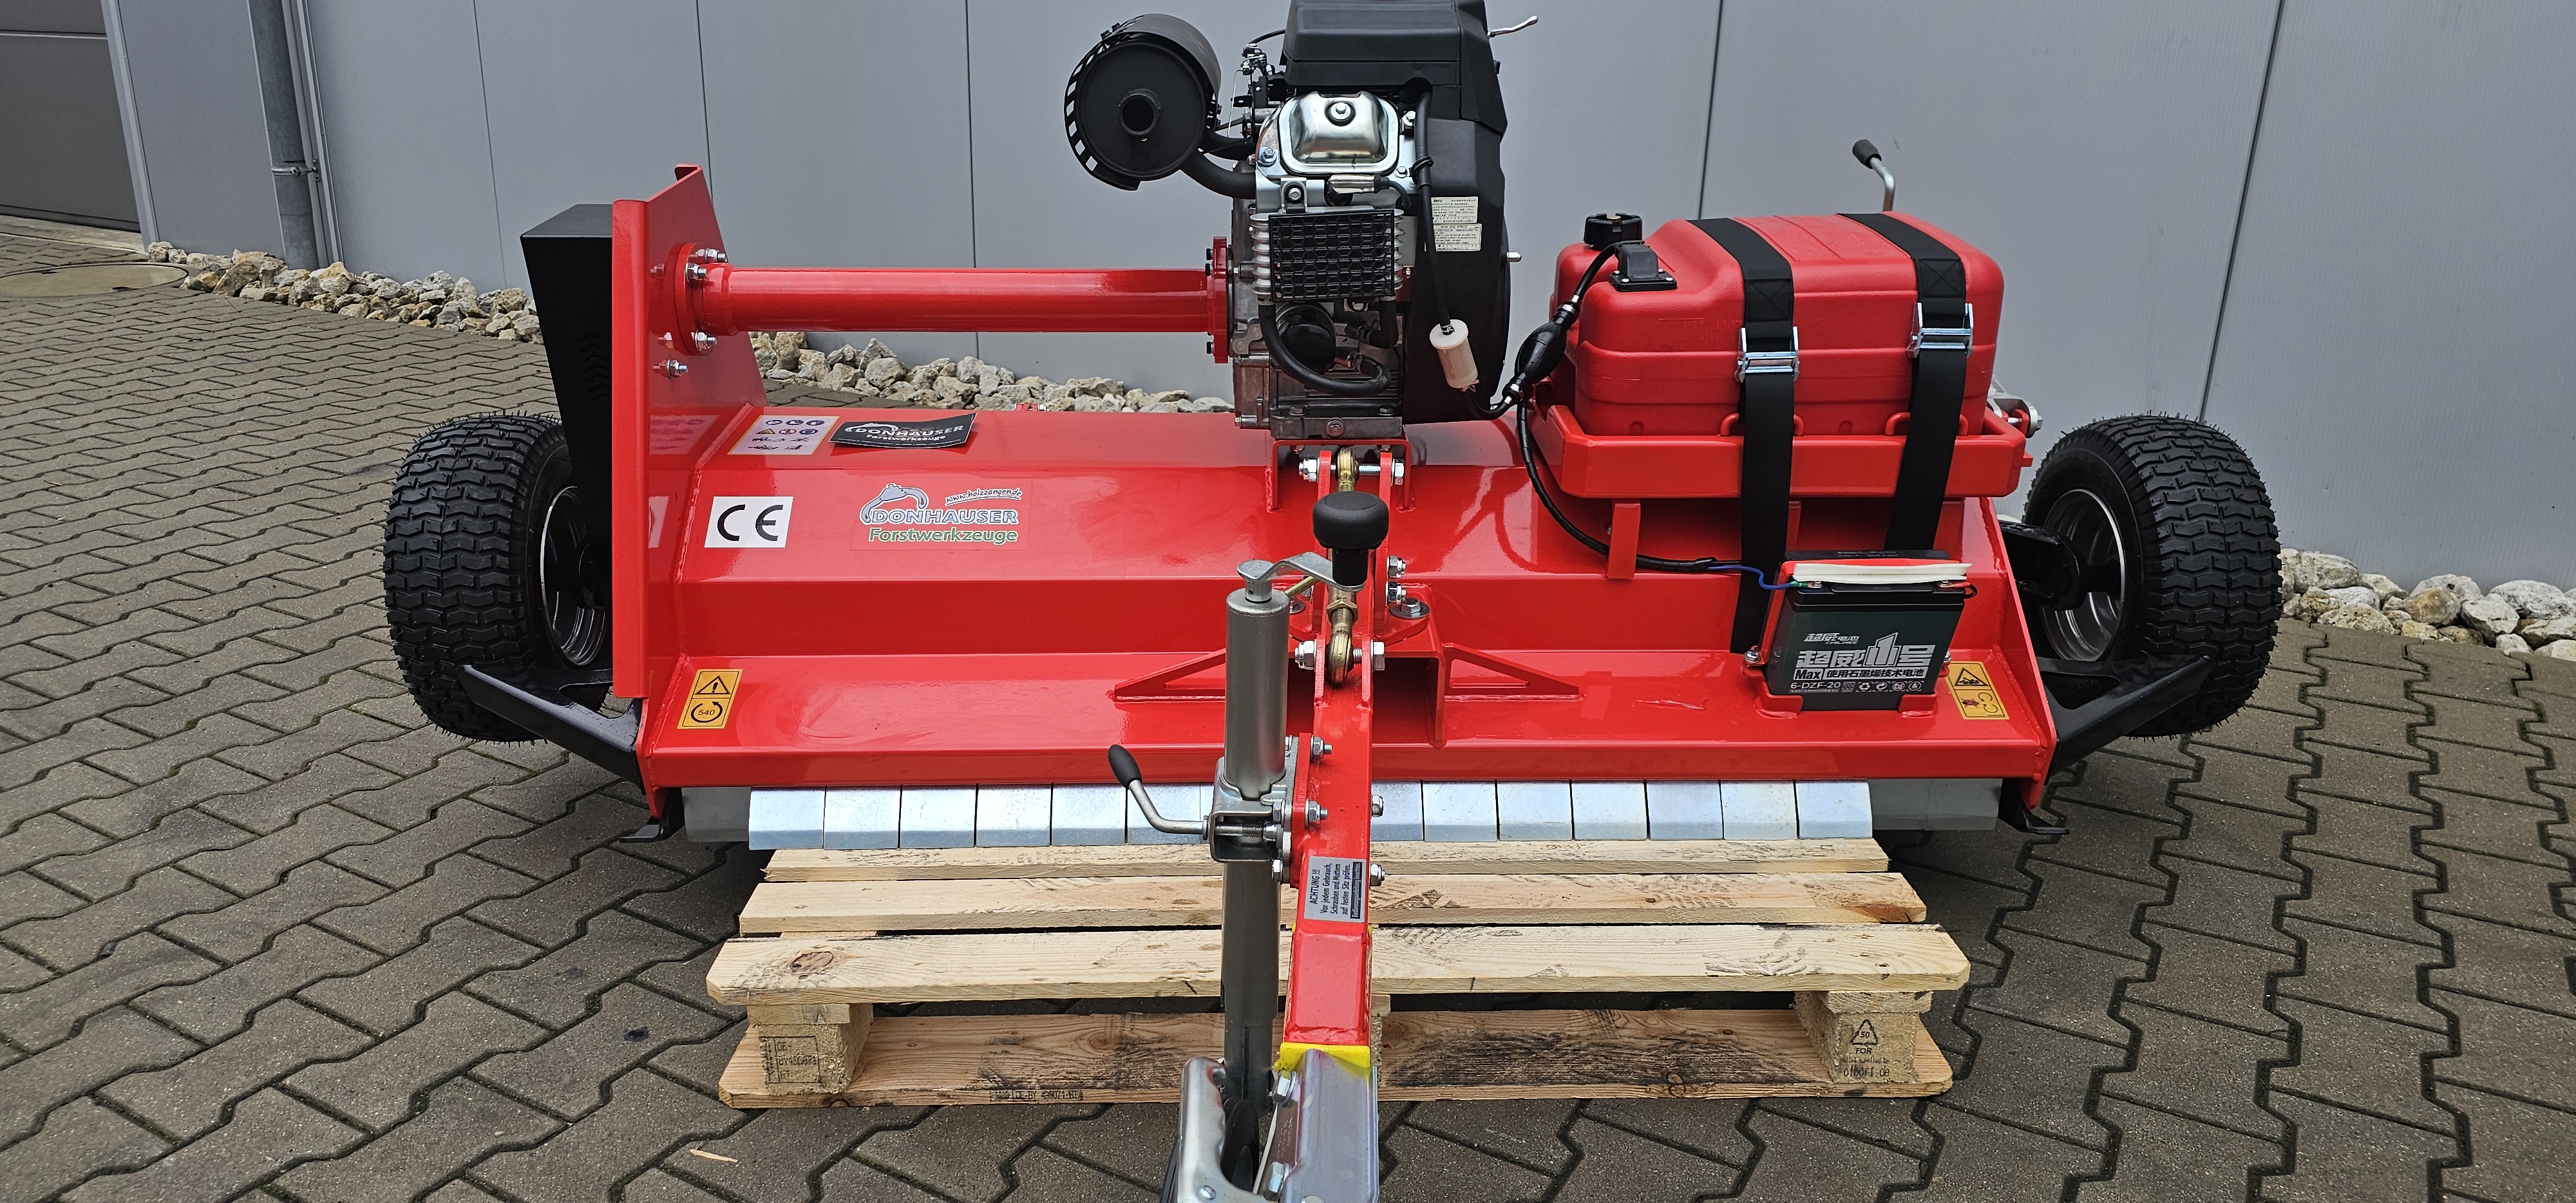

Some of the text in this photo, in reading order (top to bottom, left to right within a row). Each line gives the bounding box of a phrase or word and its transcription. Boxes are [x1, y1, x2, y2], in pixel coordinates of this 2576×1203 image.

[854, 425, 964, 437] DONHAUSER
[946, 488, 1022, 503] www.holzzangen.de
[717, 504, 784, 542] CE
[872, 509, 1018, 524] DONHAUSER
[869, 527, 1018, 544] Forstwerkzeuge
[1794, 669, 1821, 680] Max
[1310, 876, 1320, 905] ACHTUNG
[1320, 863, 1333, 913] Vor jedem Gebrauch,
[1331, 891, 1340, 914] Schrauben
[1341, 891, 1349, 905] festen
